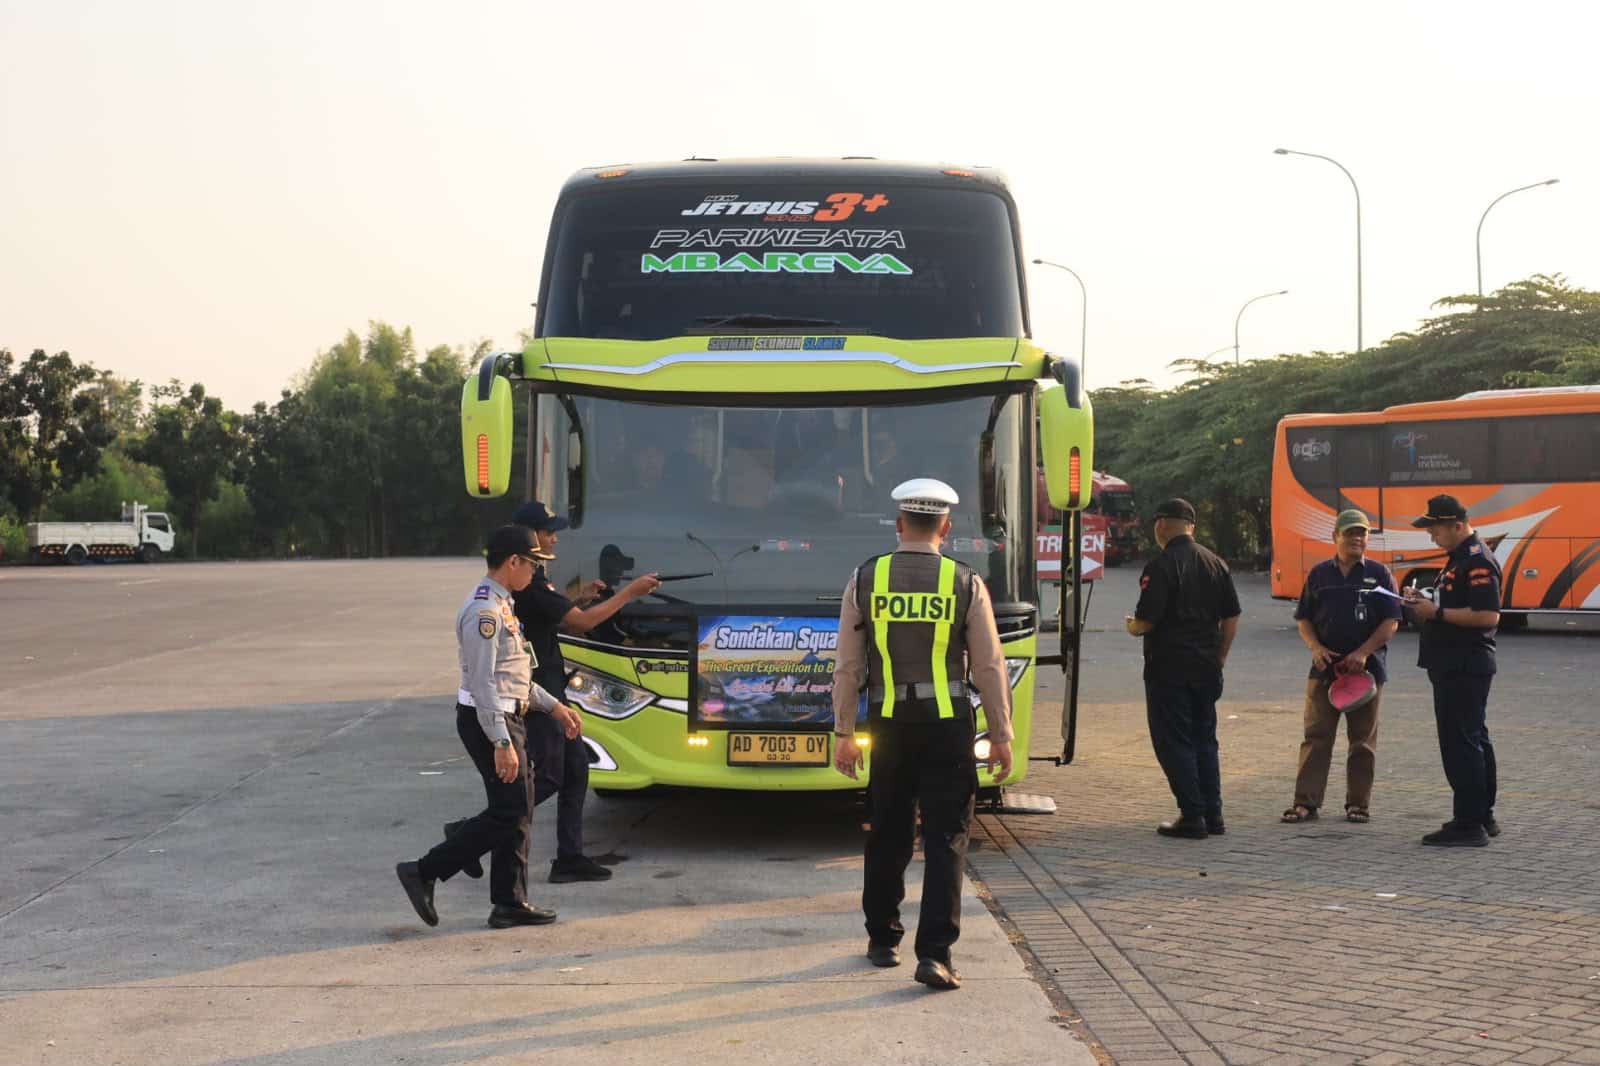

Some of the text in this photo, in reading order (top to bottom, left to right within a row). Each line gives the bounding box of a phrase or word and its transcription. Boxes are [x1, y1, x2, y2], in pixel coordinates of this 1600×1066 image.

[681, 192, 889, 222] JETBUS 3+
[649, 229, 906, 249] PARIWISATA
[641, 252, 913, 275] MBAREVA
[875, 595, 952, 621] POLISI
[716, 627, 838, 653] Sondakan Squa
[726, 662, 754, 673] Great
[757, 662, 811, 676] Expedition
[814, 662, 824, 673] to
[733, 736, 752, 753] AD
[759, 736, 797, 753] 7003
